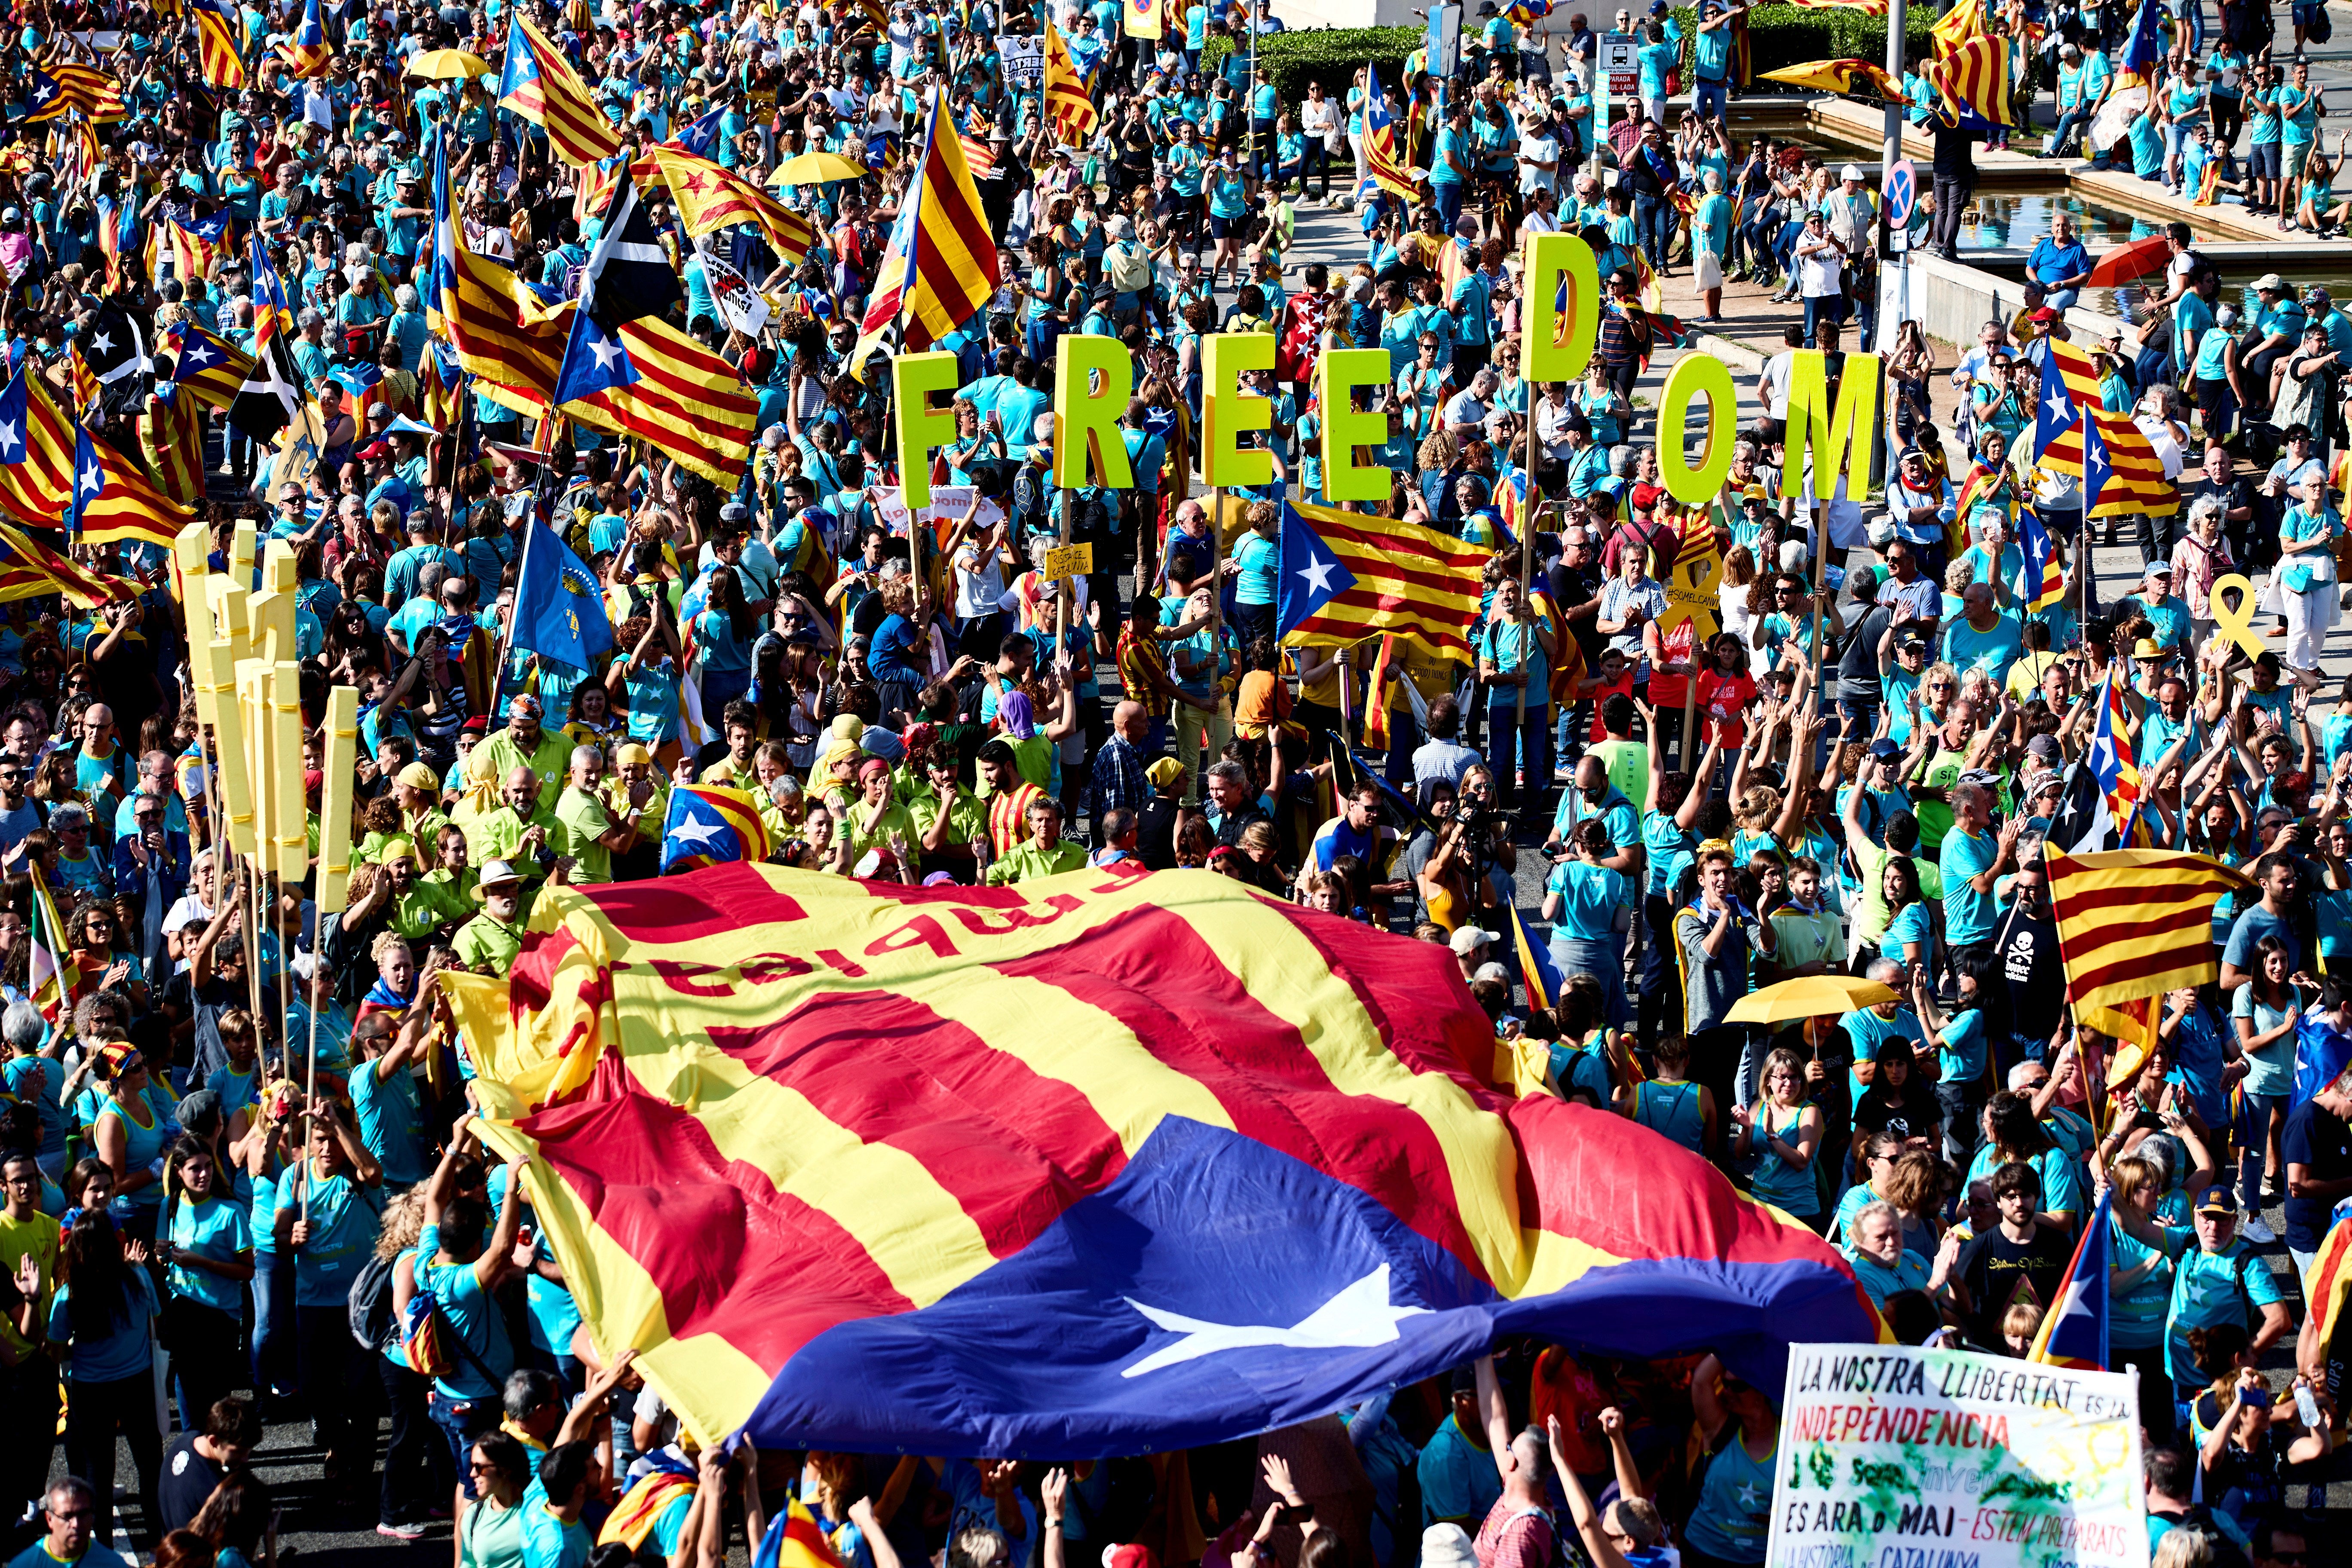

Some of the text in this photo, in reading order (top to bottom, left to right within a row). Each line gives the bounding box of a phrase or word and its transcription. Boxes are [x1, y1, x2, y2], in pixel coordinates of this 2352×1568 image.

[1428, 656, 1436, 666] DU
[1431, 669, 1447, 680] THINGS
[2018, 1257, 2033, 1271] Of
[1800, 1356, 1822, 1393] LA
[1827, 1356, 1924, 1396] NOSTRA
[1939, 1362, 2081, 1409] LLIBERTAT
[1813, 1501, 1863, 1533] ARA
[1896, 1503, 1955, 1537] MAI
[1971, 1507, 2035, 1544] ESTEM
[2038, 1515, 2127, 1557] PREPARATS
